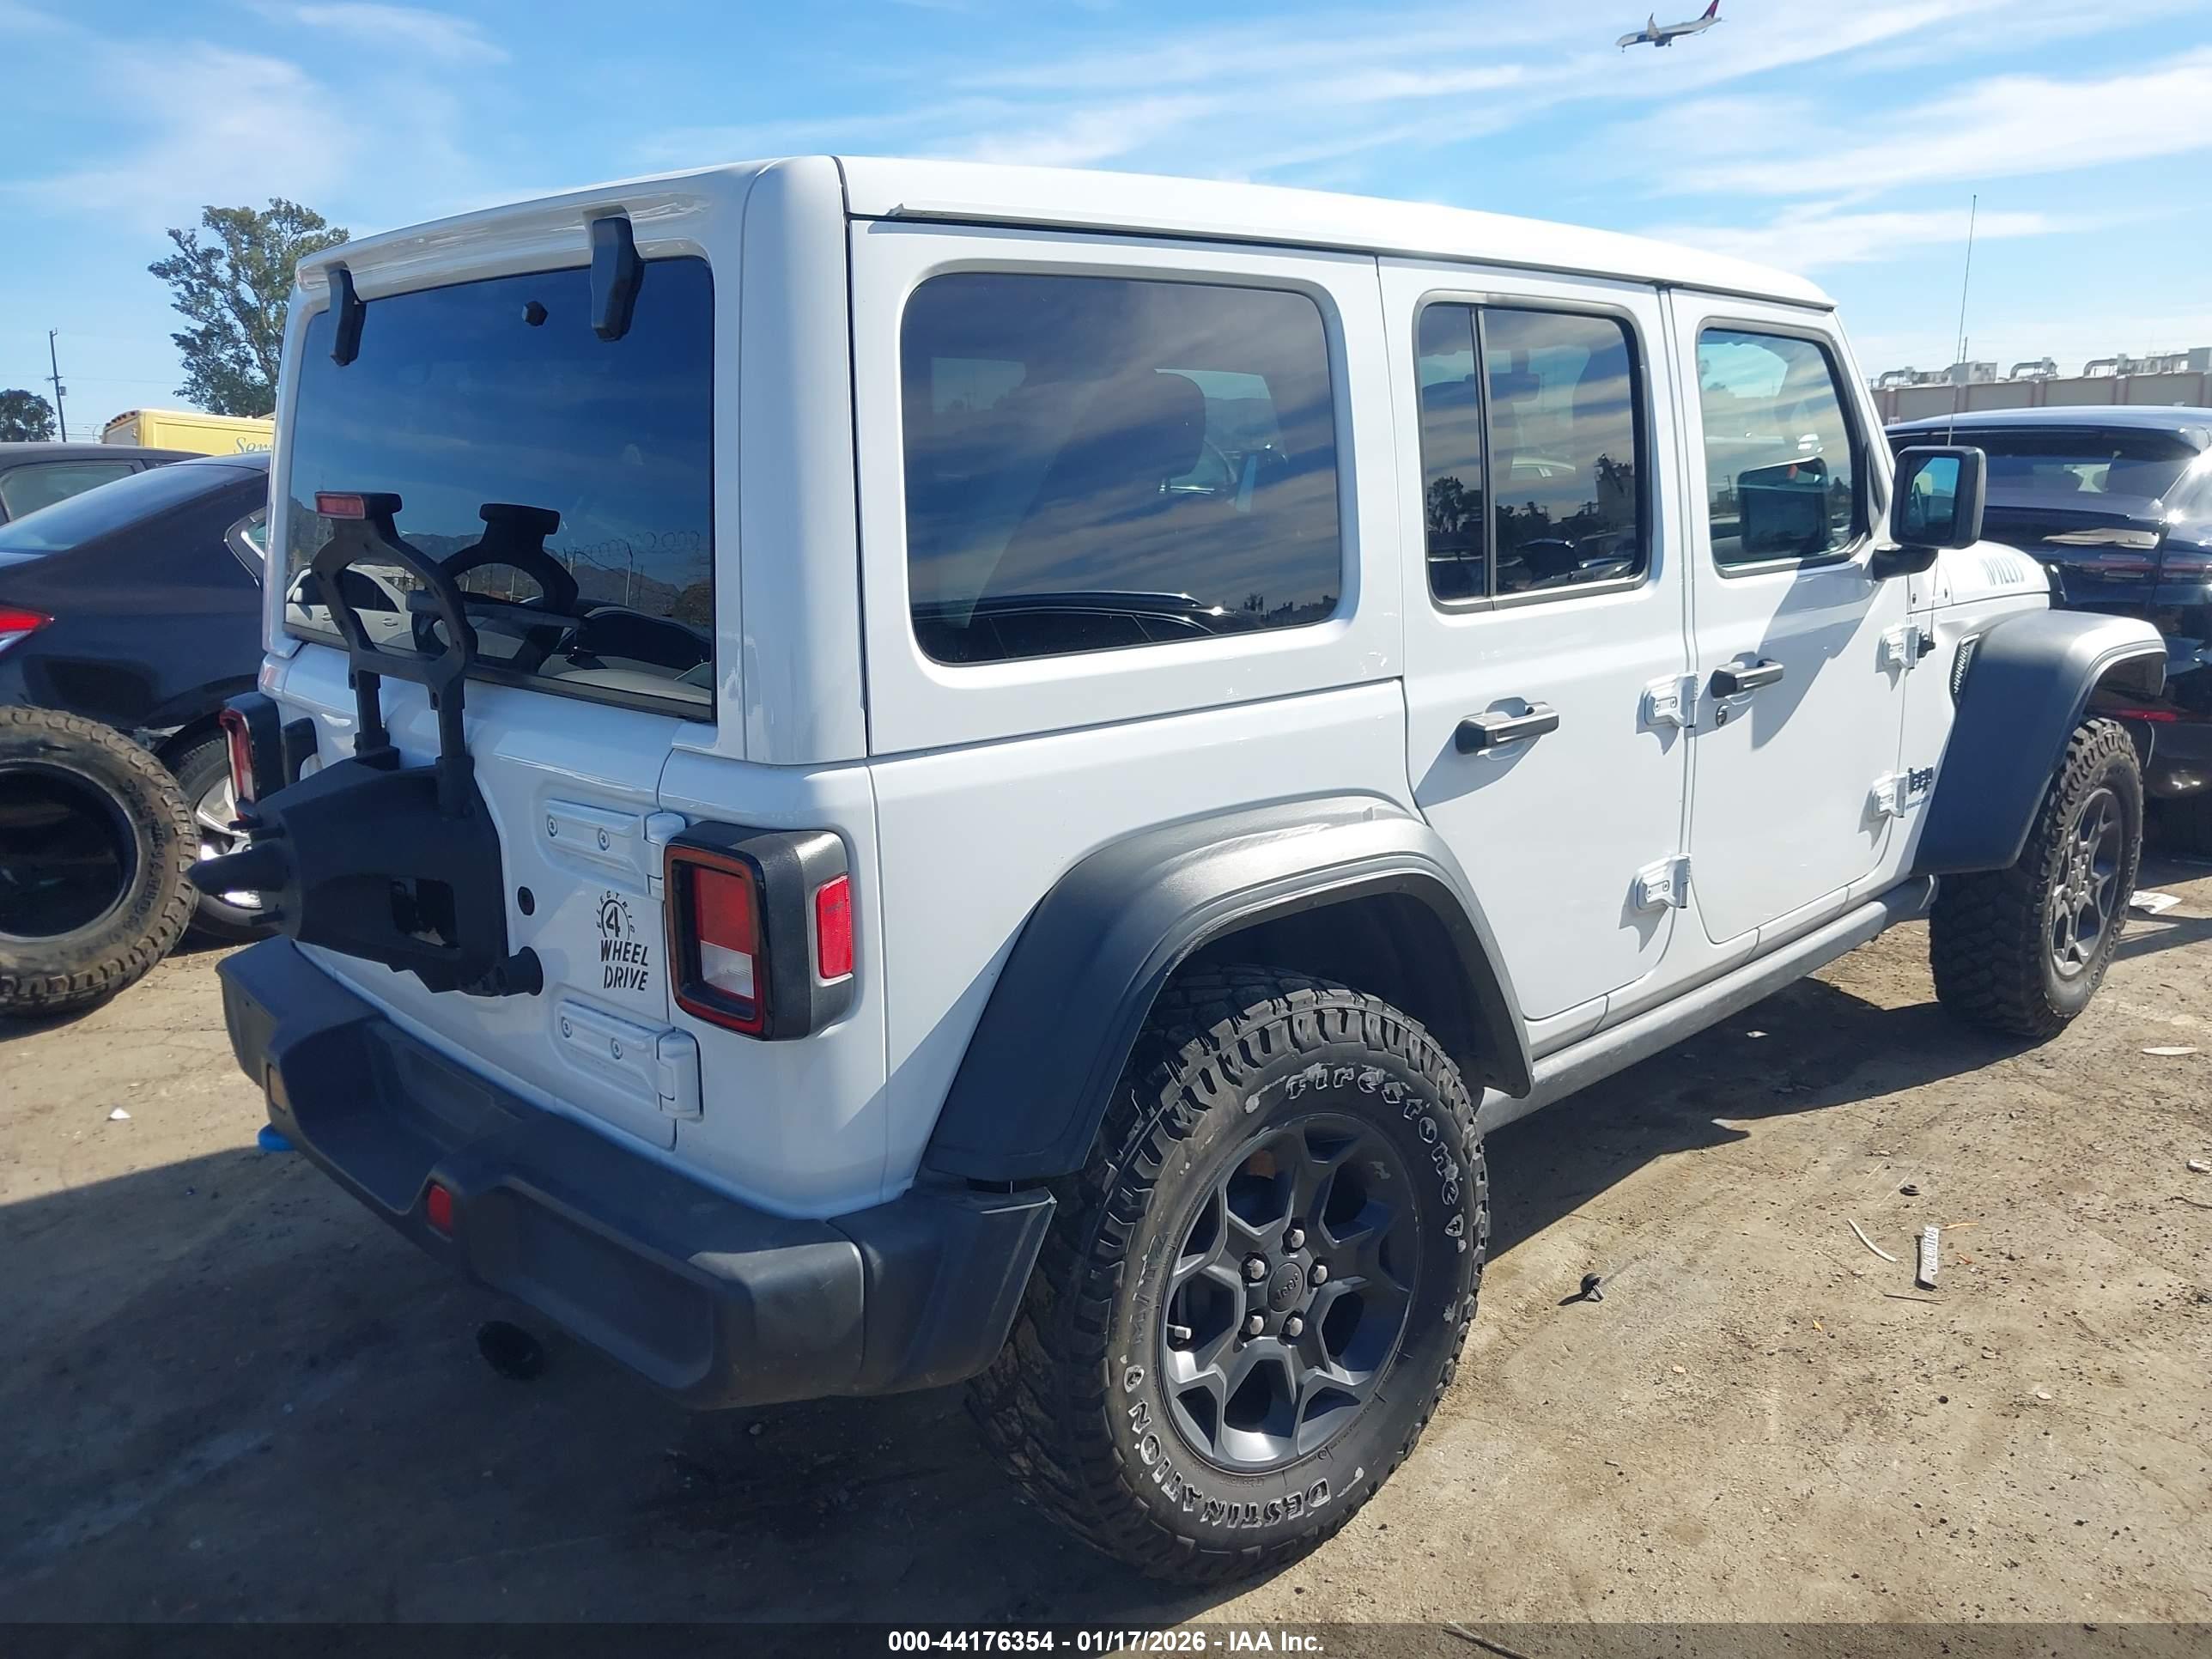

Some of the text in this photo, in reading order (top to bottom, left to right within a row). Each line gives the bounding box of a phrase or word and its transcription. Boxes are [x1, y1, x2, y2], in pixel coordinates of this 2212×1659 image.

[596, 890, 635, 933] ELECTRIC
[605, 906, 620, 938] 4
[600, 939, 648, 967] WHEEL
[603, 965, 648, 991] DRIVE
[1276, 1272, 1299, 1303] Jeep
[1127, 1400, 1331, 1528] DESTINATION
